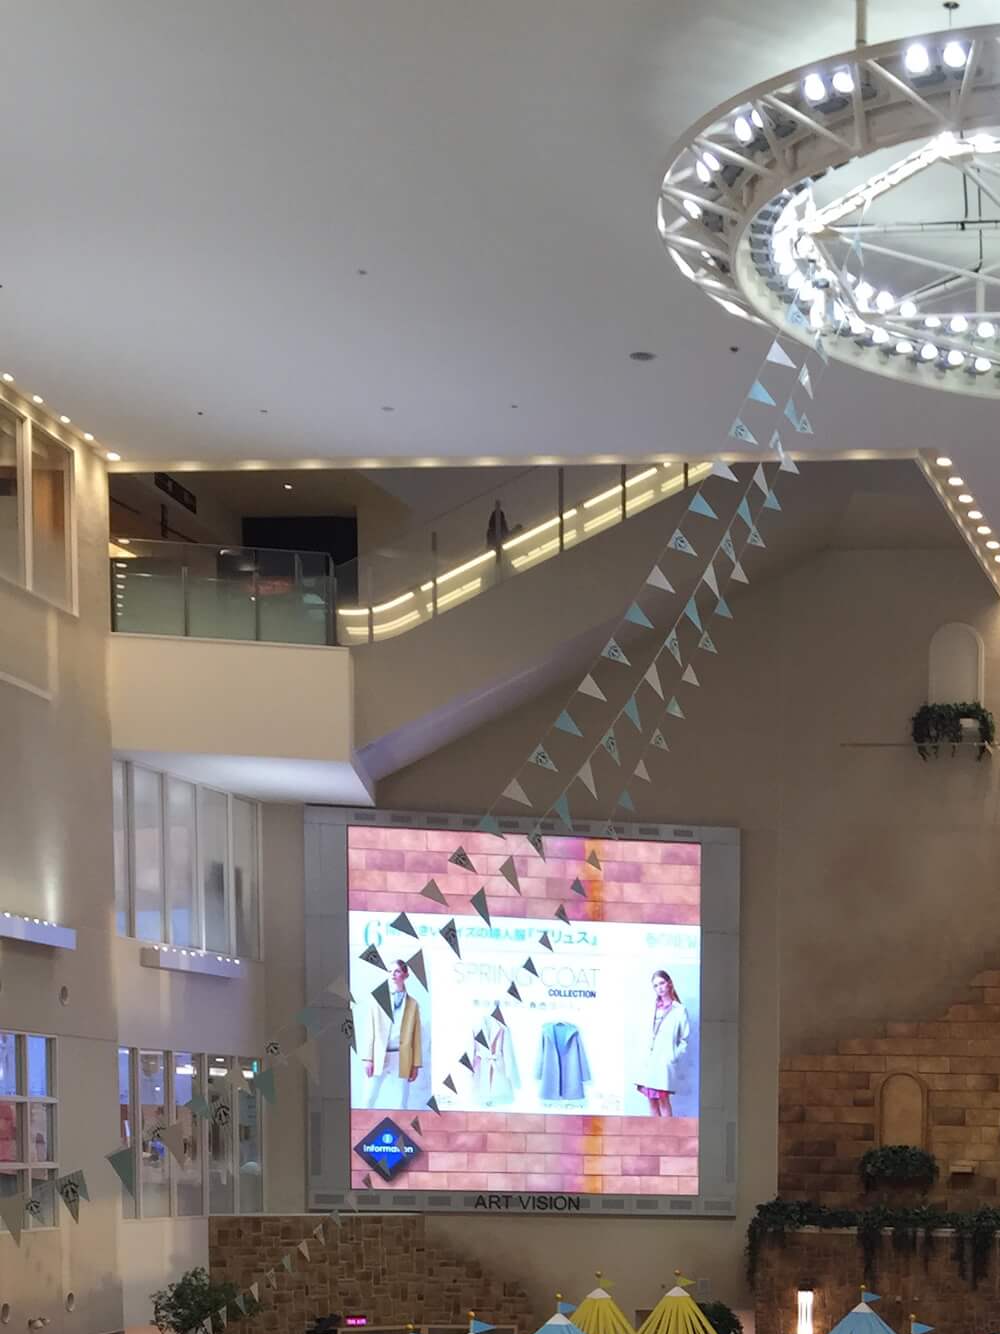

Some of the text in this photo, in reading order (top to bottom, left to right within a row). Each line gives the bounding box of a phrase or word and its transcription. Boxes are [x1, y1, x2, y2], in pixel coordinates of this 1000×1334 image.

[454, 961, 601, 988] SPRING COAT
[547, 988, 597, 998] COLLECTION
[363, 1144, 414, 1153] Informaon
[474, 1194, 581, 1211] ART VISION
